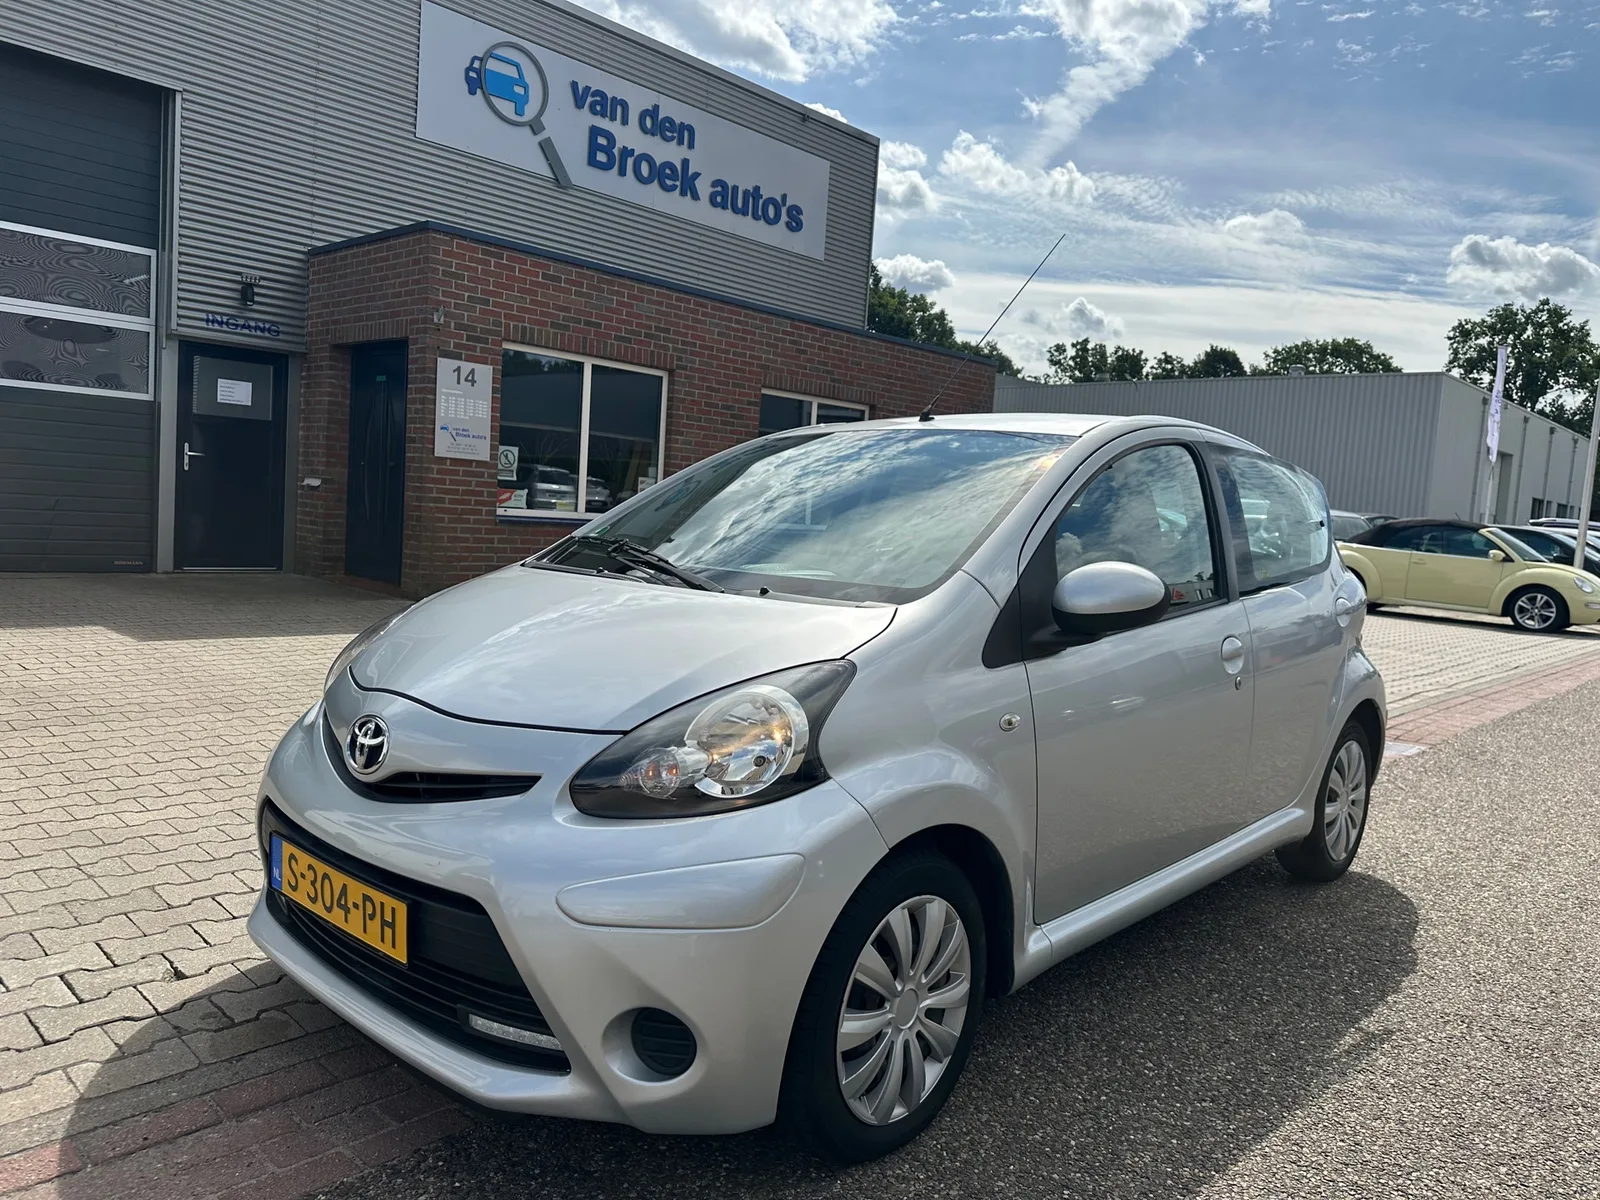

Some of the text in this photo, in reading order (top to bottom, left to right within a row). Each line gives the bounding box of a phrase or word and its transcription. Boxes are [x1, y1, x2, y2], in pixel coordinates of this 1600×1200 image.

[570, 79, 696, 150] van den
[587, 124, 804, 233] Broek auto's
[205, 313, 281, 337] INGANG
[452, 365, 477, 387] 14
[273, 852, 397, 950] NL S-304-PH
